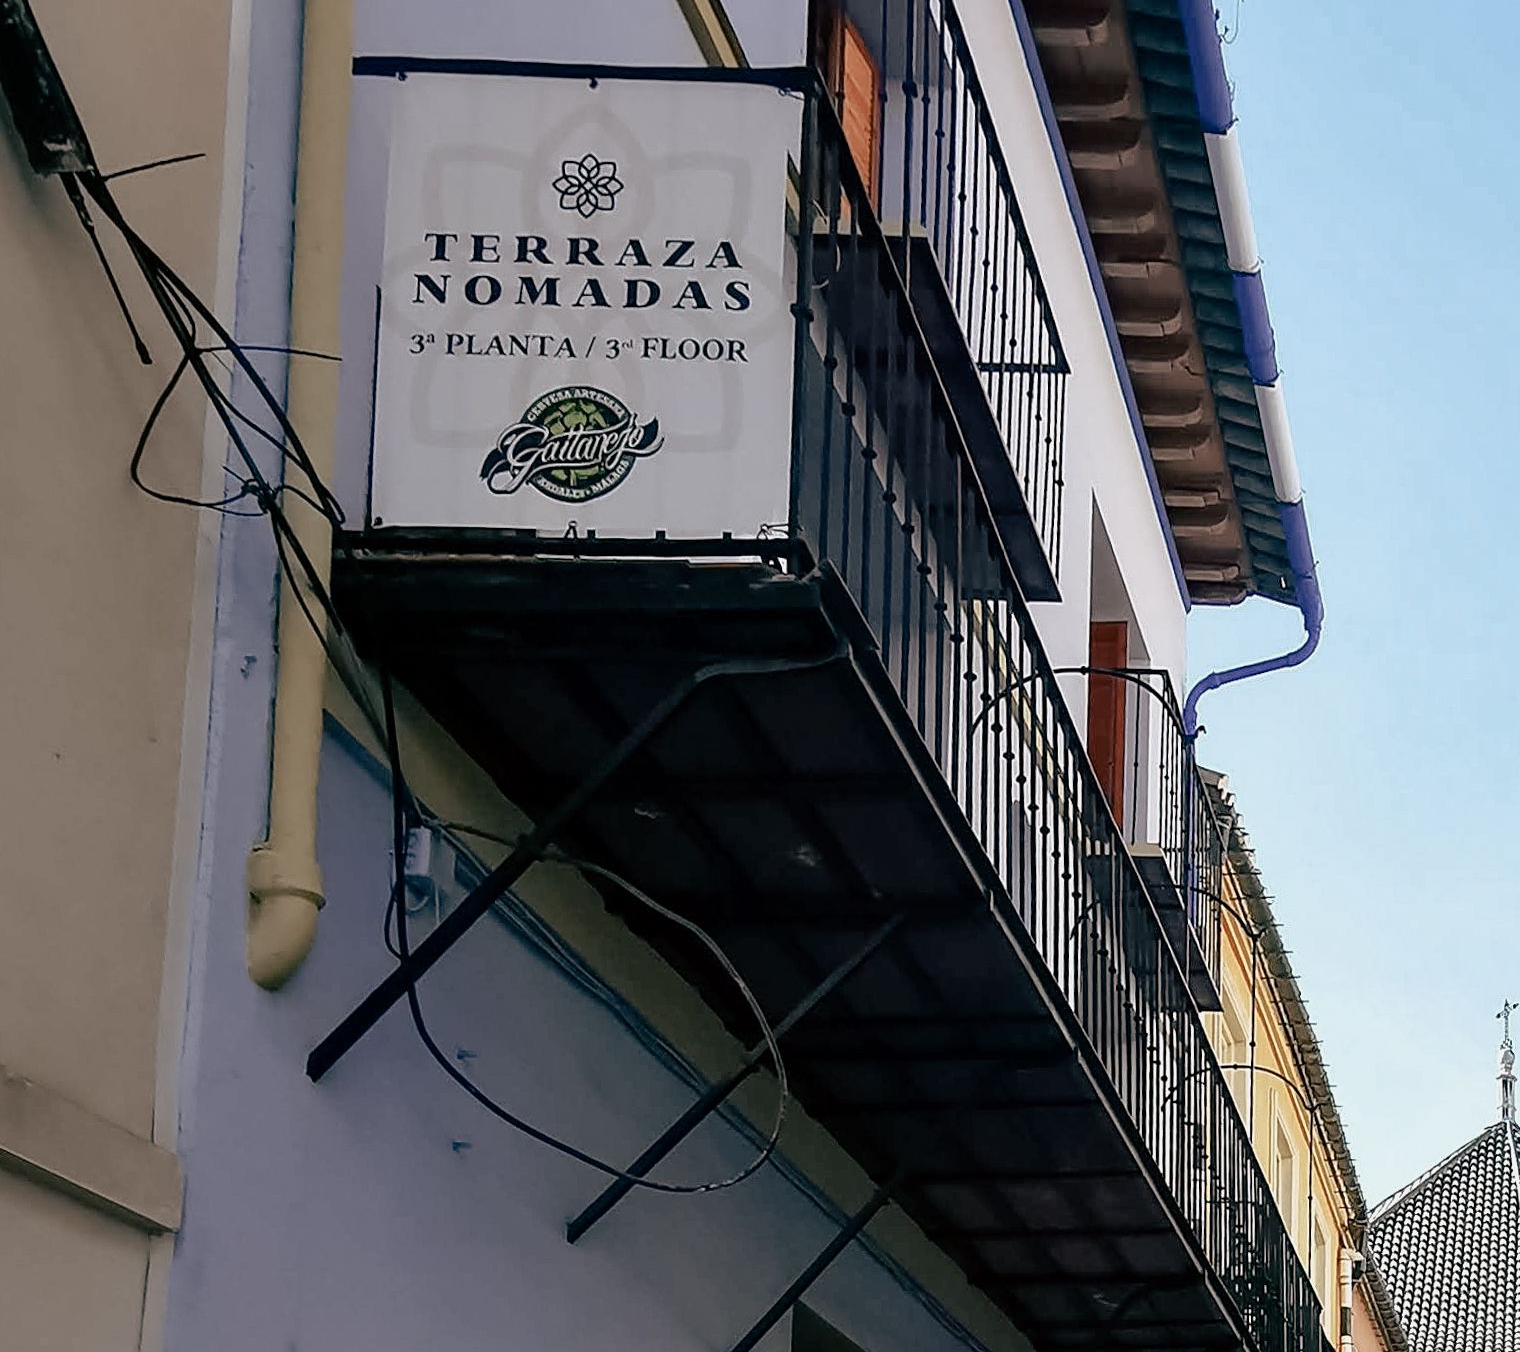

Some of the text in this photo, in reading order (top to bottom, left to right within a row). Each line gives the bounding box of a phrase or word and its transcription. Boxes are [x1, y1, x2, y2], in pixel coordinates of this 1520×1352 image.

[424, 232, 743, 269] TERRAZA
[412, 274, 751, 312] NOMADAS
[446, 333, 577, 359] PLANTA
[606, 337, 634, 360] 3rd
[642, 337, 749, 363] FLOOR
